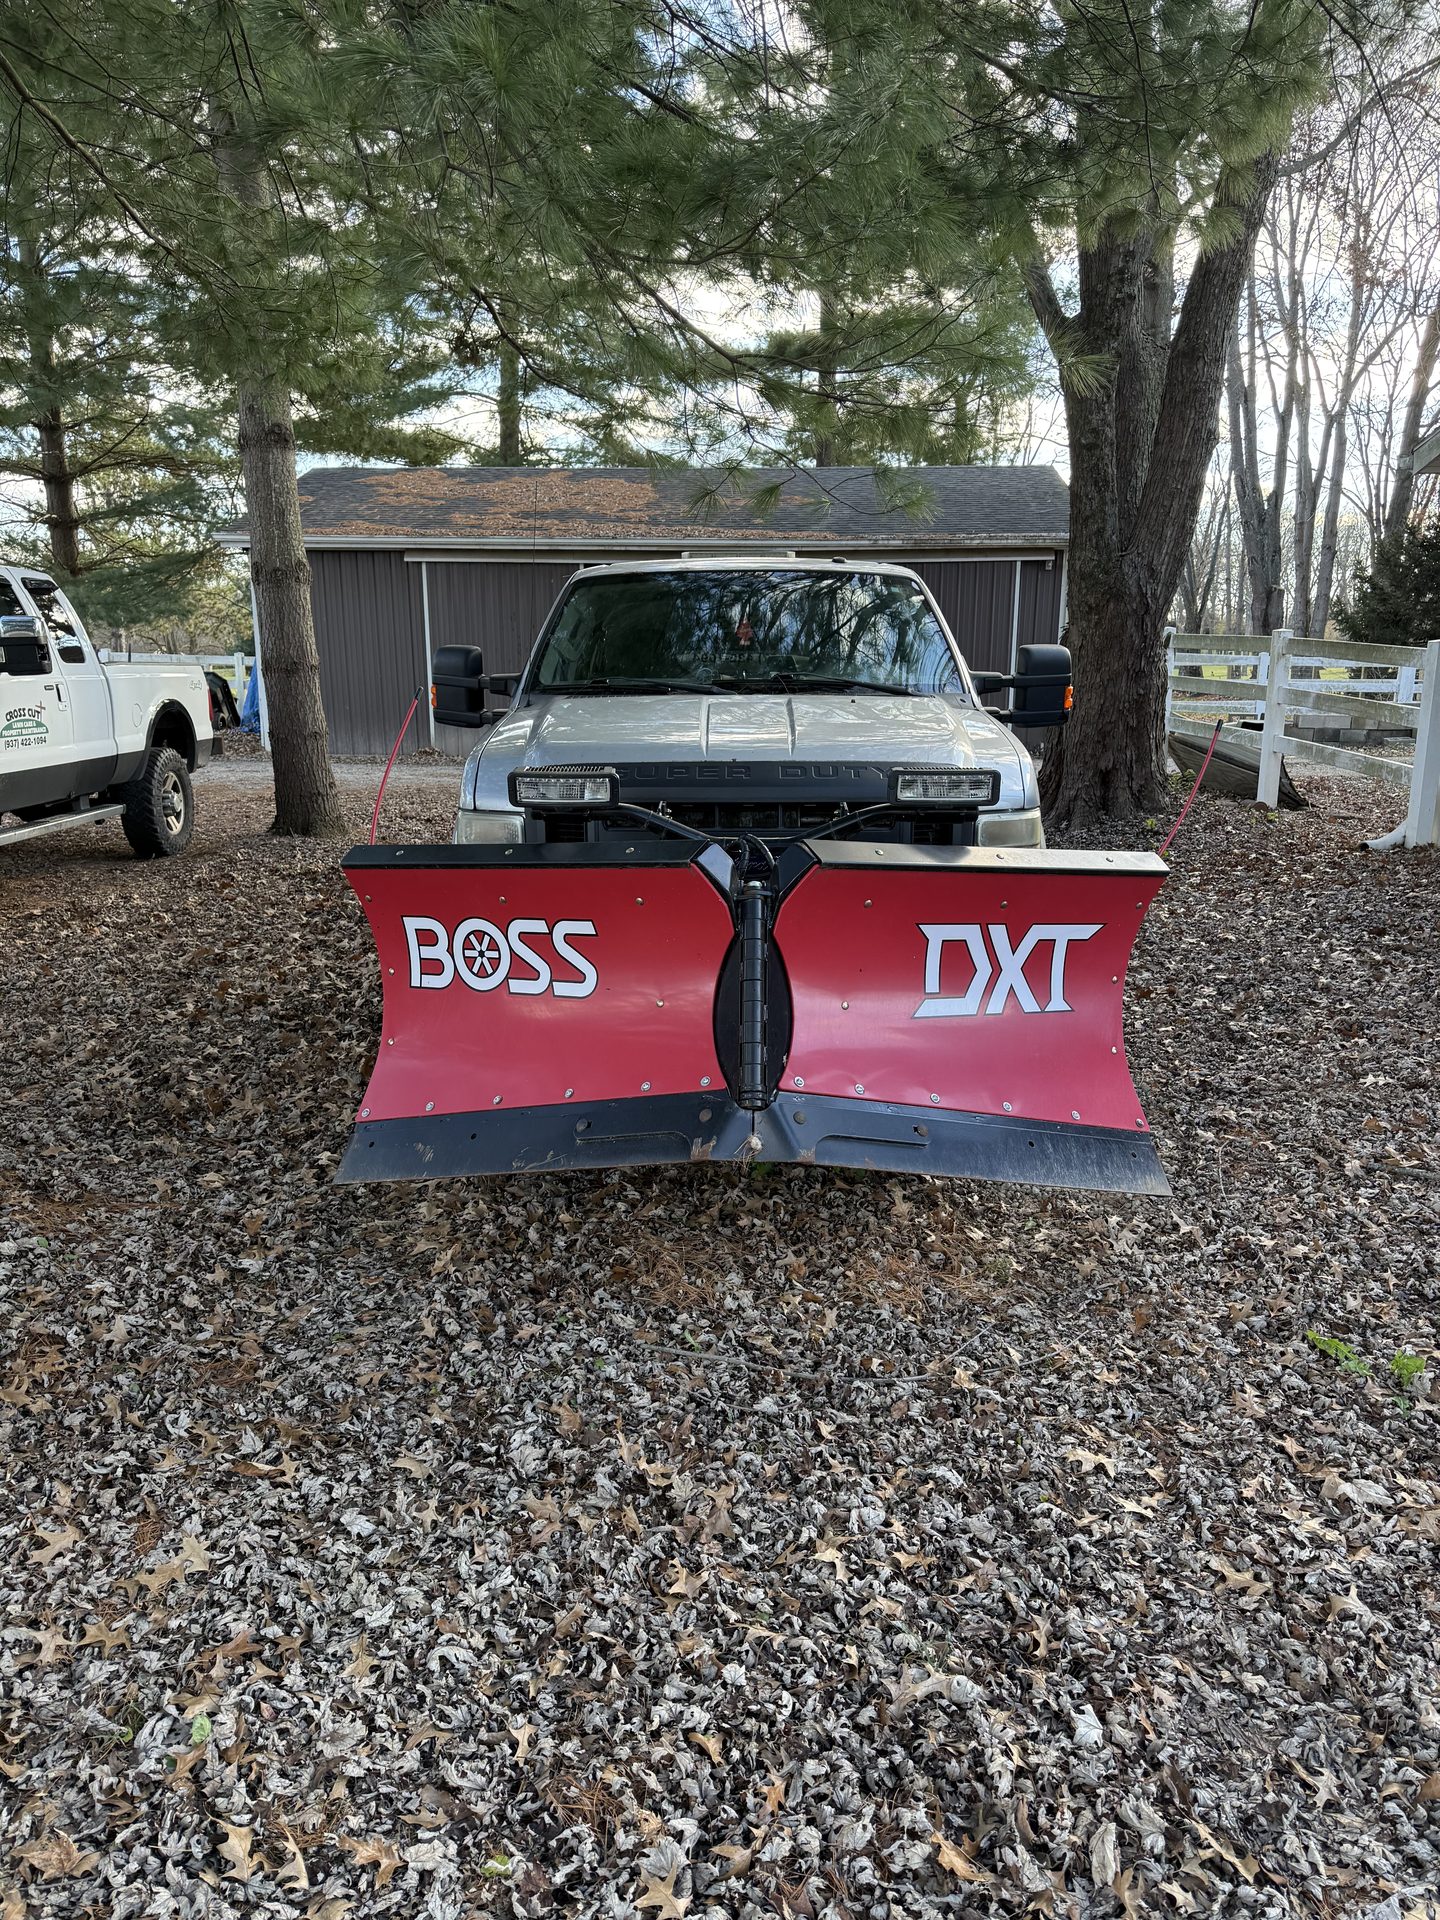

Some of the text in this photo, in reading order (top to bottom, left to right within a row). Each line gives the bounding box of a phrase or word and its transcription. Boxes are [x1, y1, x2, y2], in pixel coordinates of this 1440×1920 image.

[5, 708, 41, 722] CROSS CUT
[4, 736, 47, 750] (937) 422-1094
[779, 765, 892, 780] DUTY
[401, 915, 599, 998] BOSS
[911, 922, 1107, 1019] DXT
